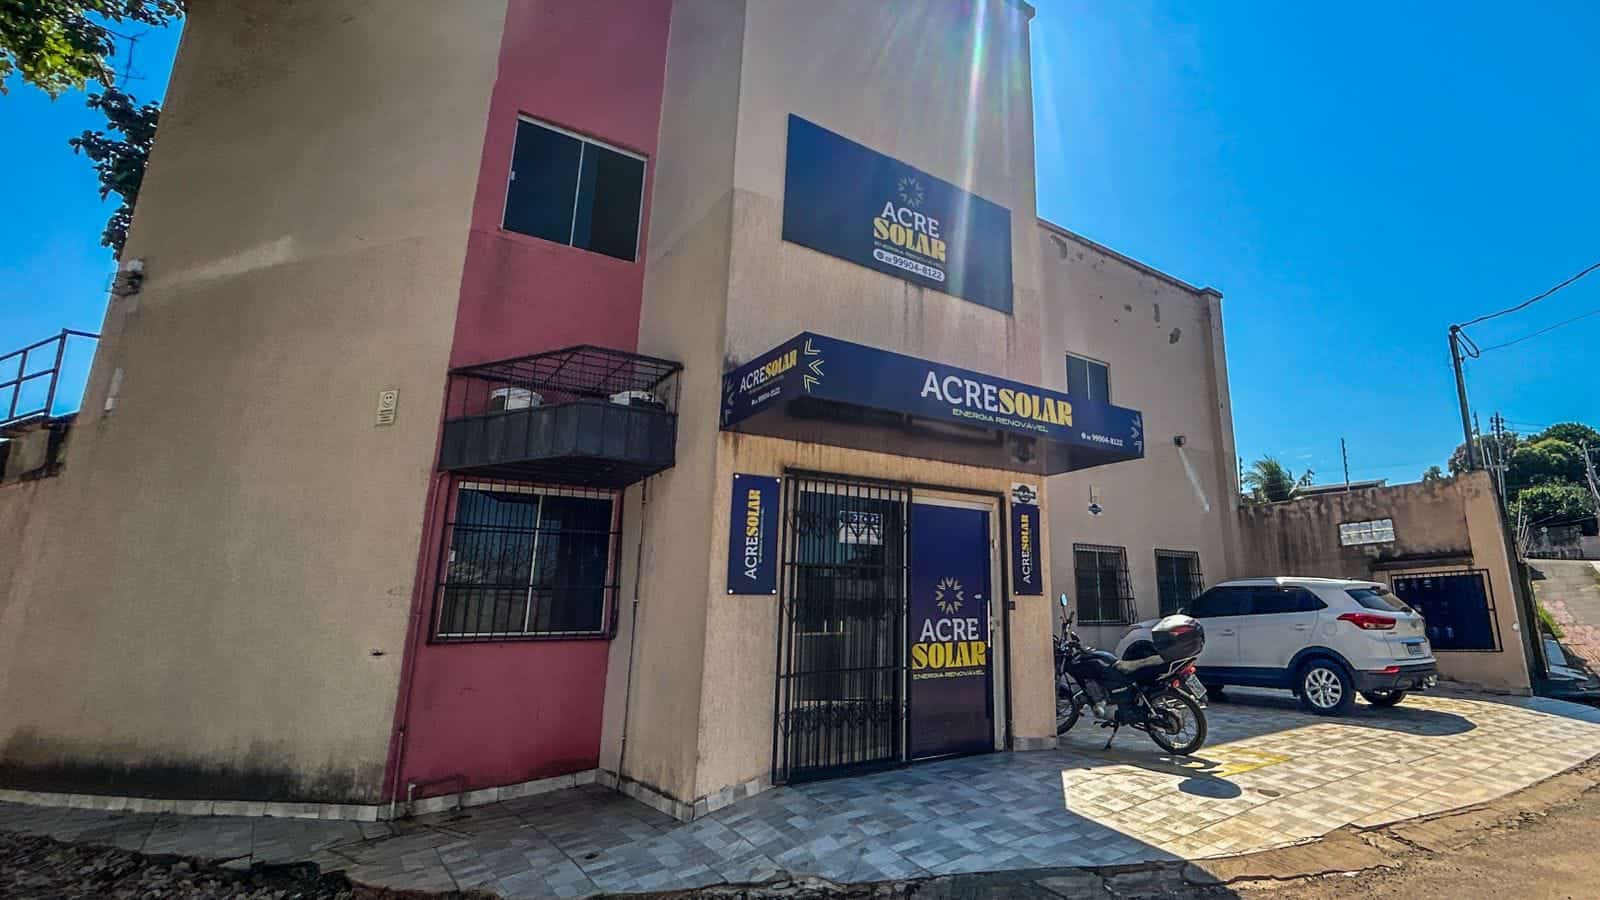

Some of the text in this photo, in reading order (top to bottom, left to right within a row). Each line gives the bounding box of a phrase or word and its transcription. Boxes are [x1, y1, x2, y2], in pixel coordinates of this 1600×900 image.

[881, 201, 940, 239] ACRE
[873, 217, 946, 262] SOLAR
[892, 256, 943, 279] 99904-8122
[952, 408, 993, 422] ENERGIA
[919, 618, 979, 642] ACRE
[911, 641, 987, 670] SOLAR
